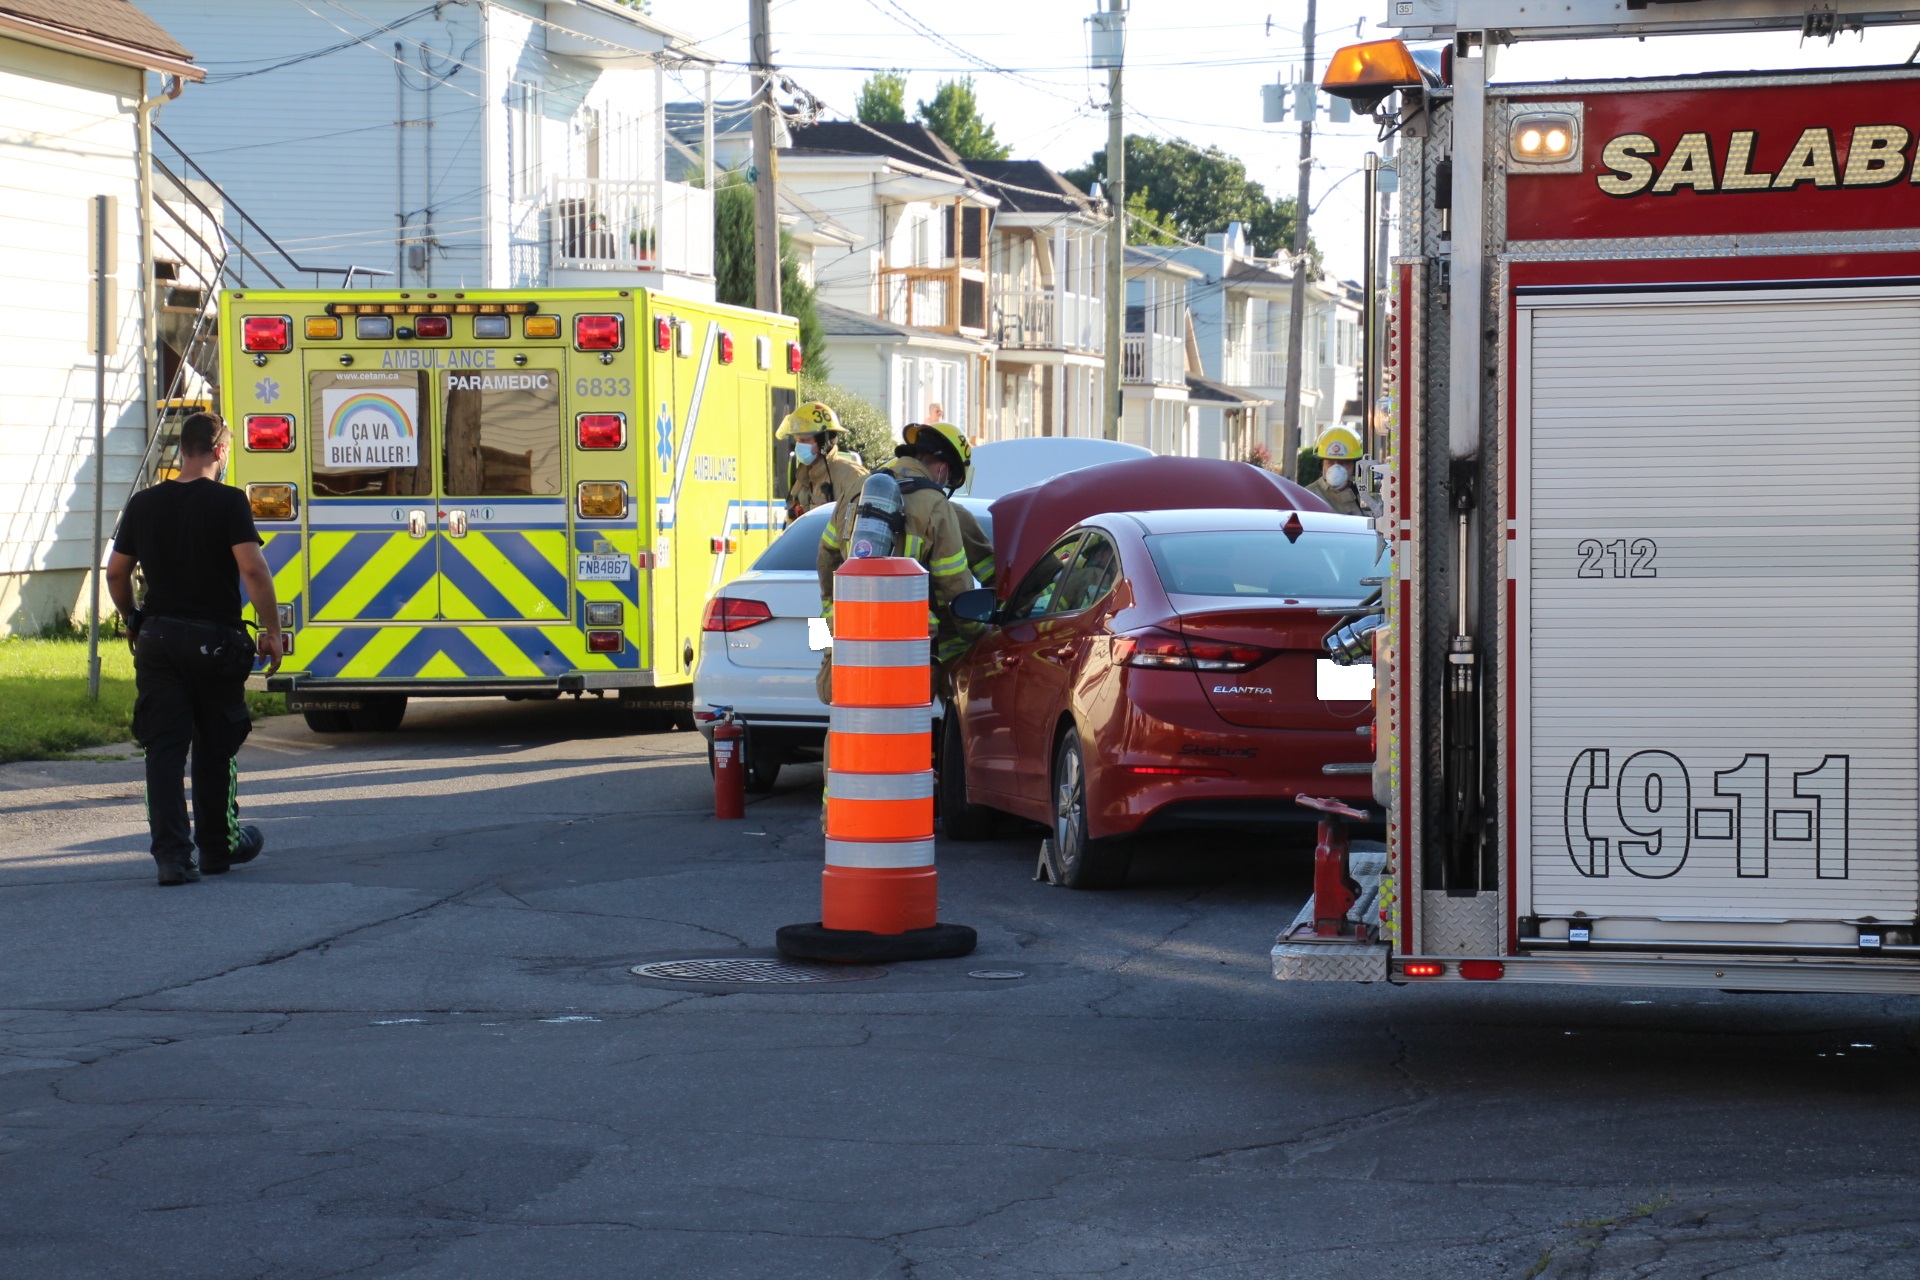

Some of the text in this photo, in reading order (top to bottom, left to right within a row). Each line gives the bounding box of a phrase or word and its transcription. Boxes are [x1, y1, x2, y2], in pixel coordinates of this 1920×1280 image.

[1596, 124, 1920, 199] SALAB
[381, 350, 496, 369] AMBULANCE
[336, 372, 399, 382] www.cetam.ca
[447, 375, 549, 391] PARAMEDIC
[575, 378, 631, 397] 6833
[812, 409, 832, 424] 36
[351, 423, 389, 446] ÇA VA
[331, 446, 363, 464] BIEN
[693, 456, 737, 481] AMBULANCE
[579, 560, 628, 574] FNB4867
[1577, 538, 1658, 578] 212
[1213, 685, 1273, 695] ELANTRA
[291, 702, 361, 711] DEMERS
